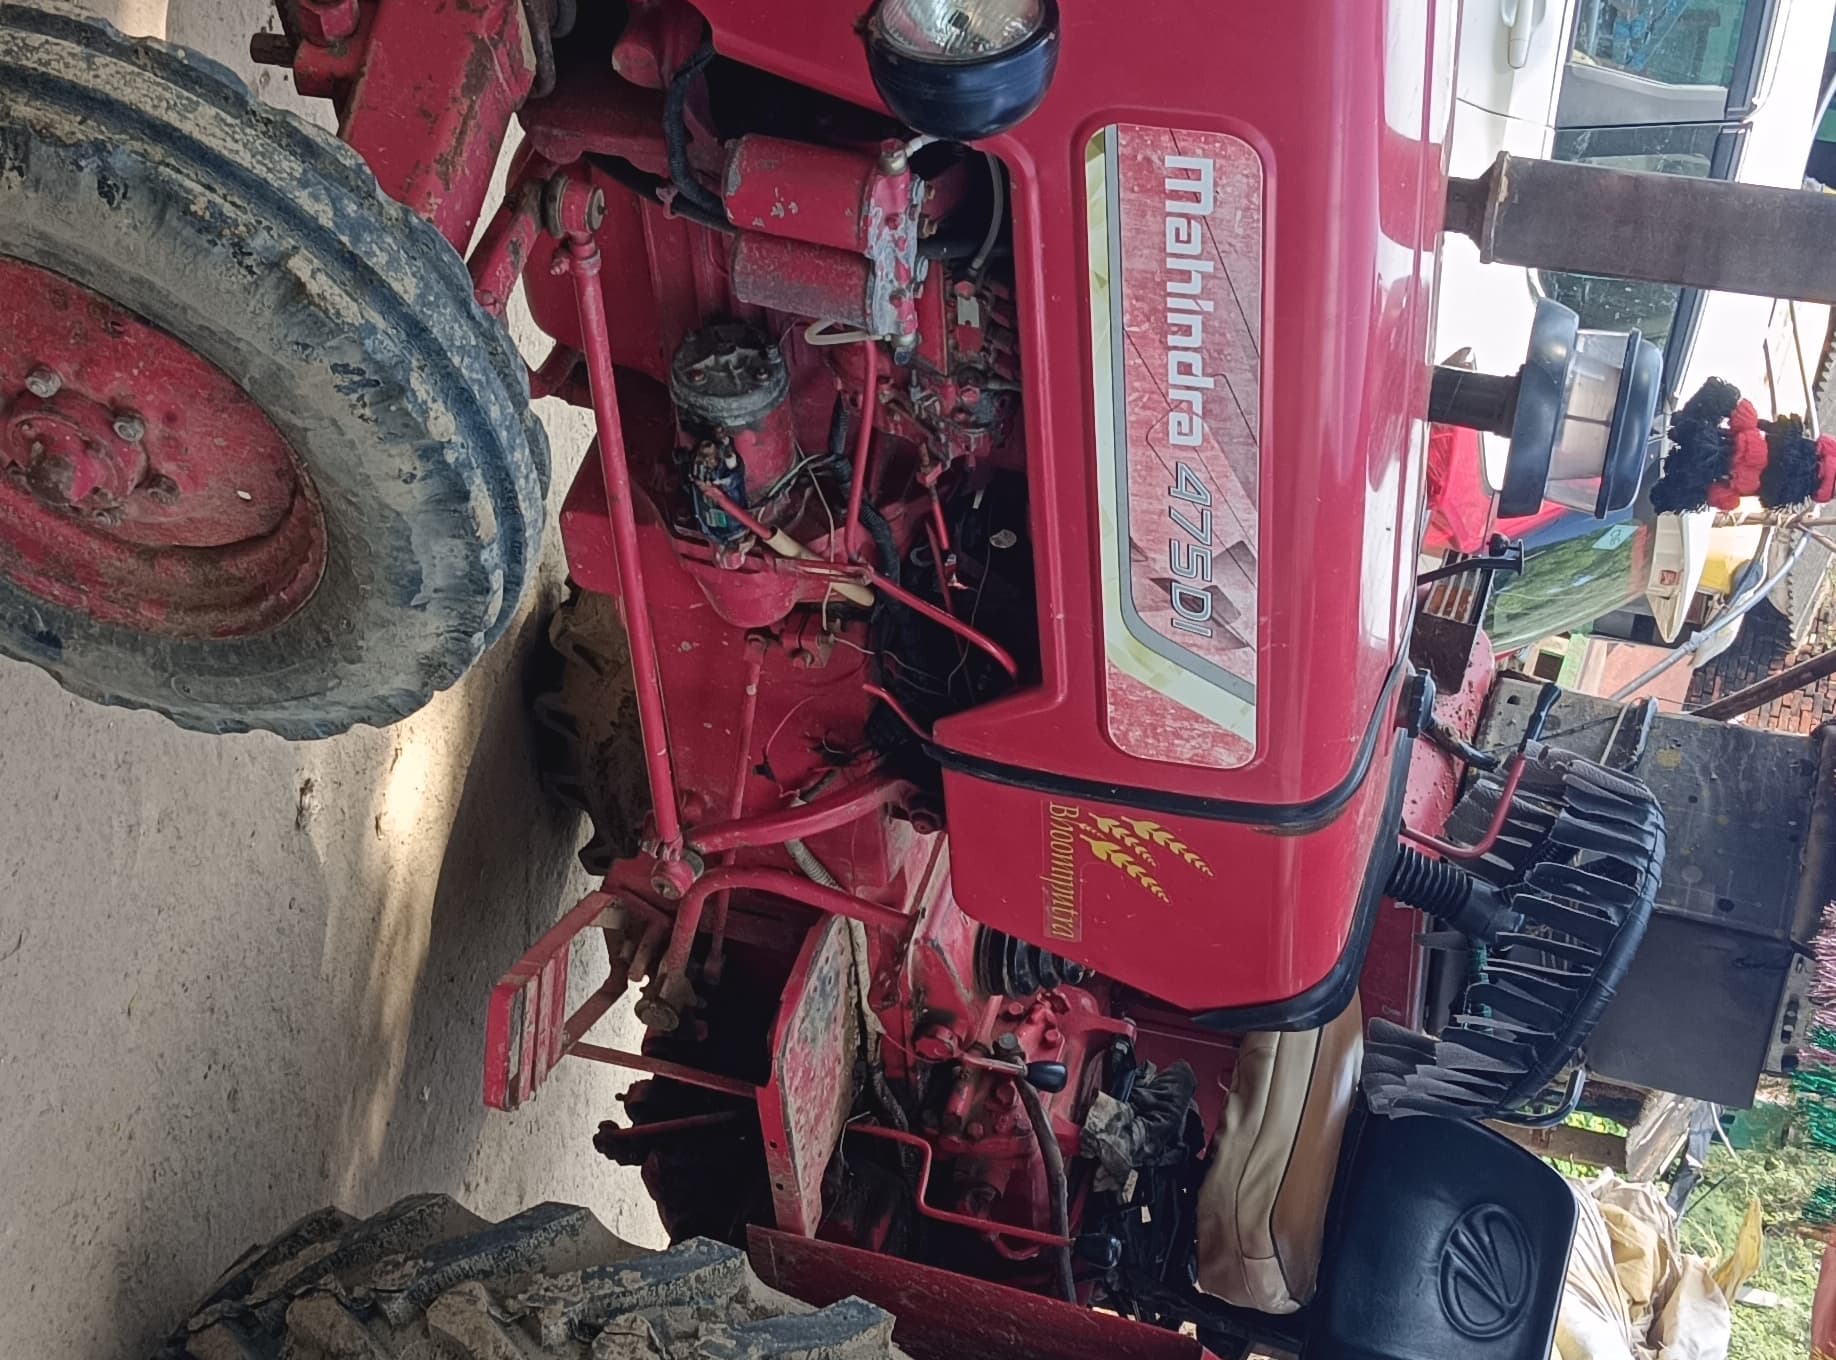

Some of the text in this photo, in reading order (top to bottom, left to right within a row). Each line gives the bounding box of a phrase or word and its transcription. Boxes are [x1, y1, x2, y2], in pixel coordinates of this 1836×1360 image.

[1164, 155, 1215, 638] Mahindra 475DI
[1039, 801, 1080, 939] Bhoomiputra
